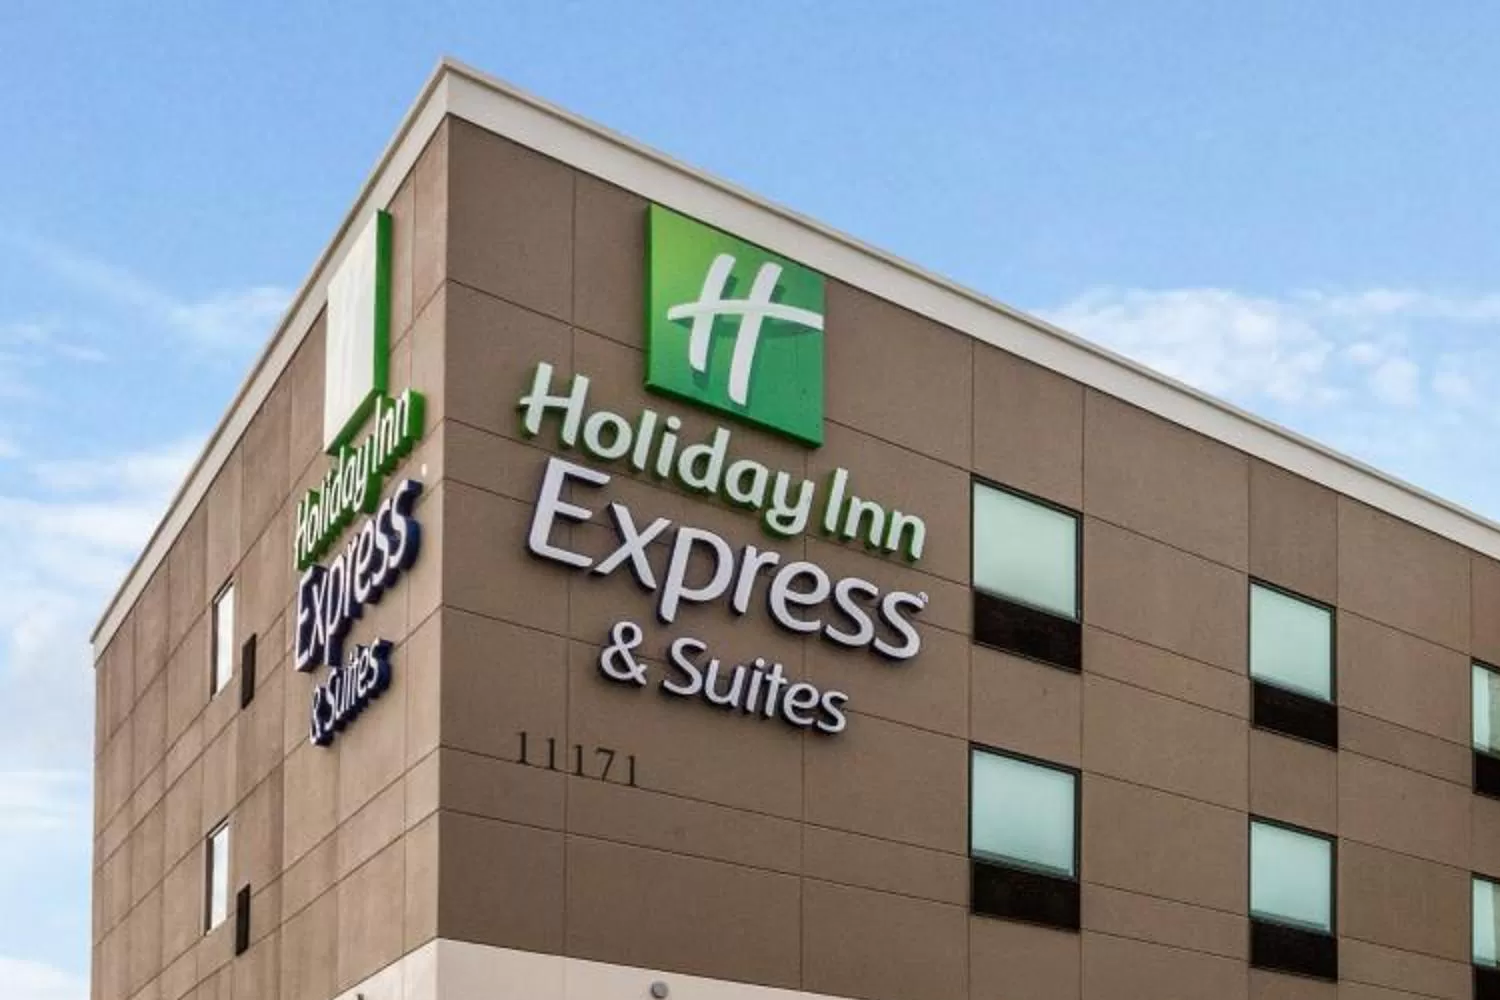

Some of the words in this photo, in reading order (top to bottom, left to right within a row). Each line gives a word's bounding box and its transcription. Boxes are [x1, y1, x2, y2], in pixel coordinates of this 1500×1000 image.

[293, 434, 374, 571] Holiday
[370, 387, 418, 475] Inn
[518, 361, 816, 539] Holiday
[822, 466, 927, 562] Inn
[293, 479, 414, 672] Express
[527, 455, 927, 661] Express
[323, 636, 385, 733] Suites
[515, 730, 638, 788] 11171
[599, 620, 648, 687] &
[661, 636, 850, 736] Suites
